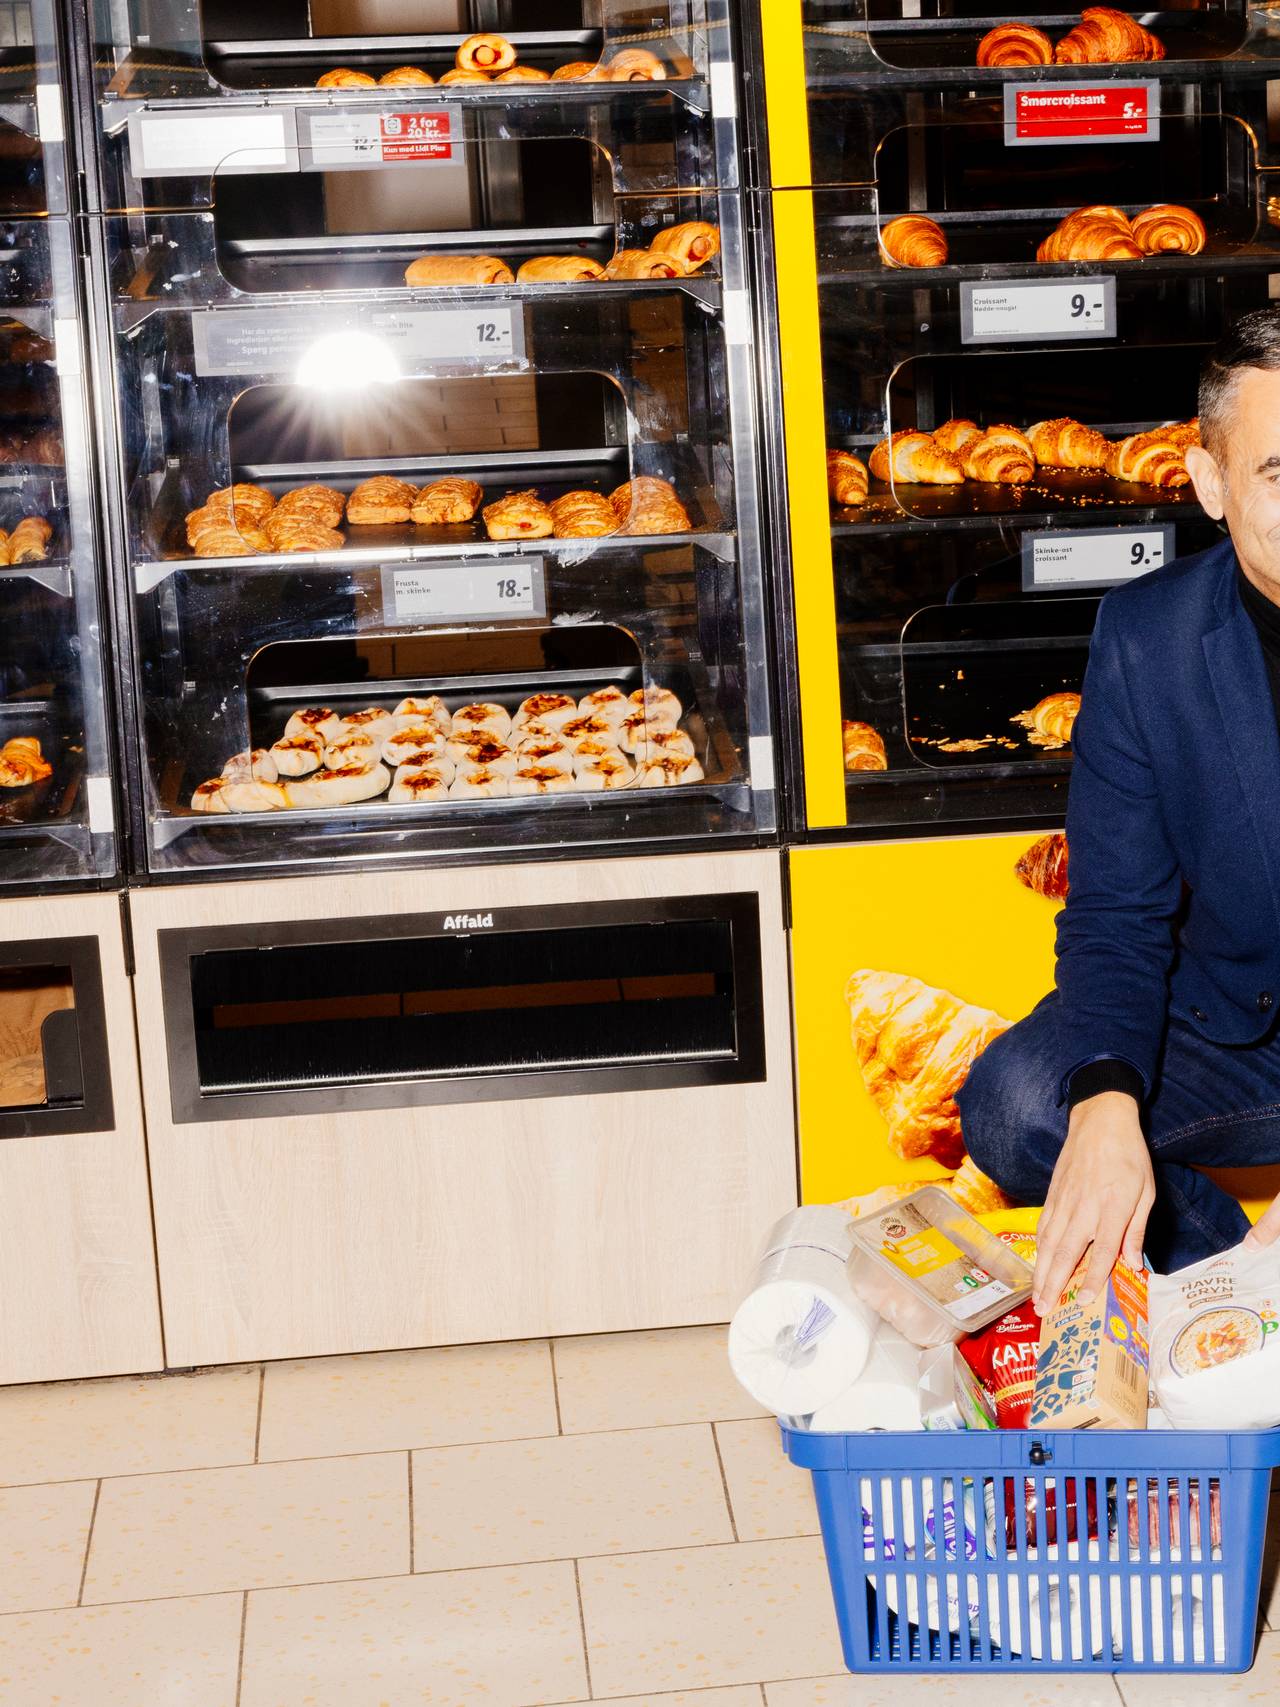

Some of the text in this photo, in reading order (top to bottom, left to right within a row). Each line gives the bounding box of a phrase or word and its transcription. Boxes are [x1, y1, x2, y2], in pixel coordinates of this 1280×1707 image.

[1020, 93, 1106, 107] Smørcroissant
[1122, 102, 1143, 118] 5.-
[410, 117, 438, 128] 2 for
[408, 127, 442, 138] 20 kr.
[399, 145, 414, 153] med
[416, 144, 429, 152] Lidl
[430, 144, 446, 152] Plus
[1071, 294, 1102, 318] 9.-
[476, 323, 510, 342] 12.-
[1130, 542, 1162, 565] 9.-
[497, 579, 530, 598] 18.-
[443, 913, 494, 930] Affald
[1182, 1277, 1238, 1293] HAVRE
[1186, 1286, 1233, 1299] GRYN
[996, 1323, 1035, 1334] Bellarom
[992, 1342, 1040, 1370] KAFF
[1012, 1365, 1038, 1374] FORMAL
